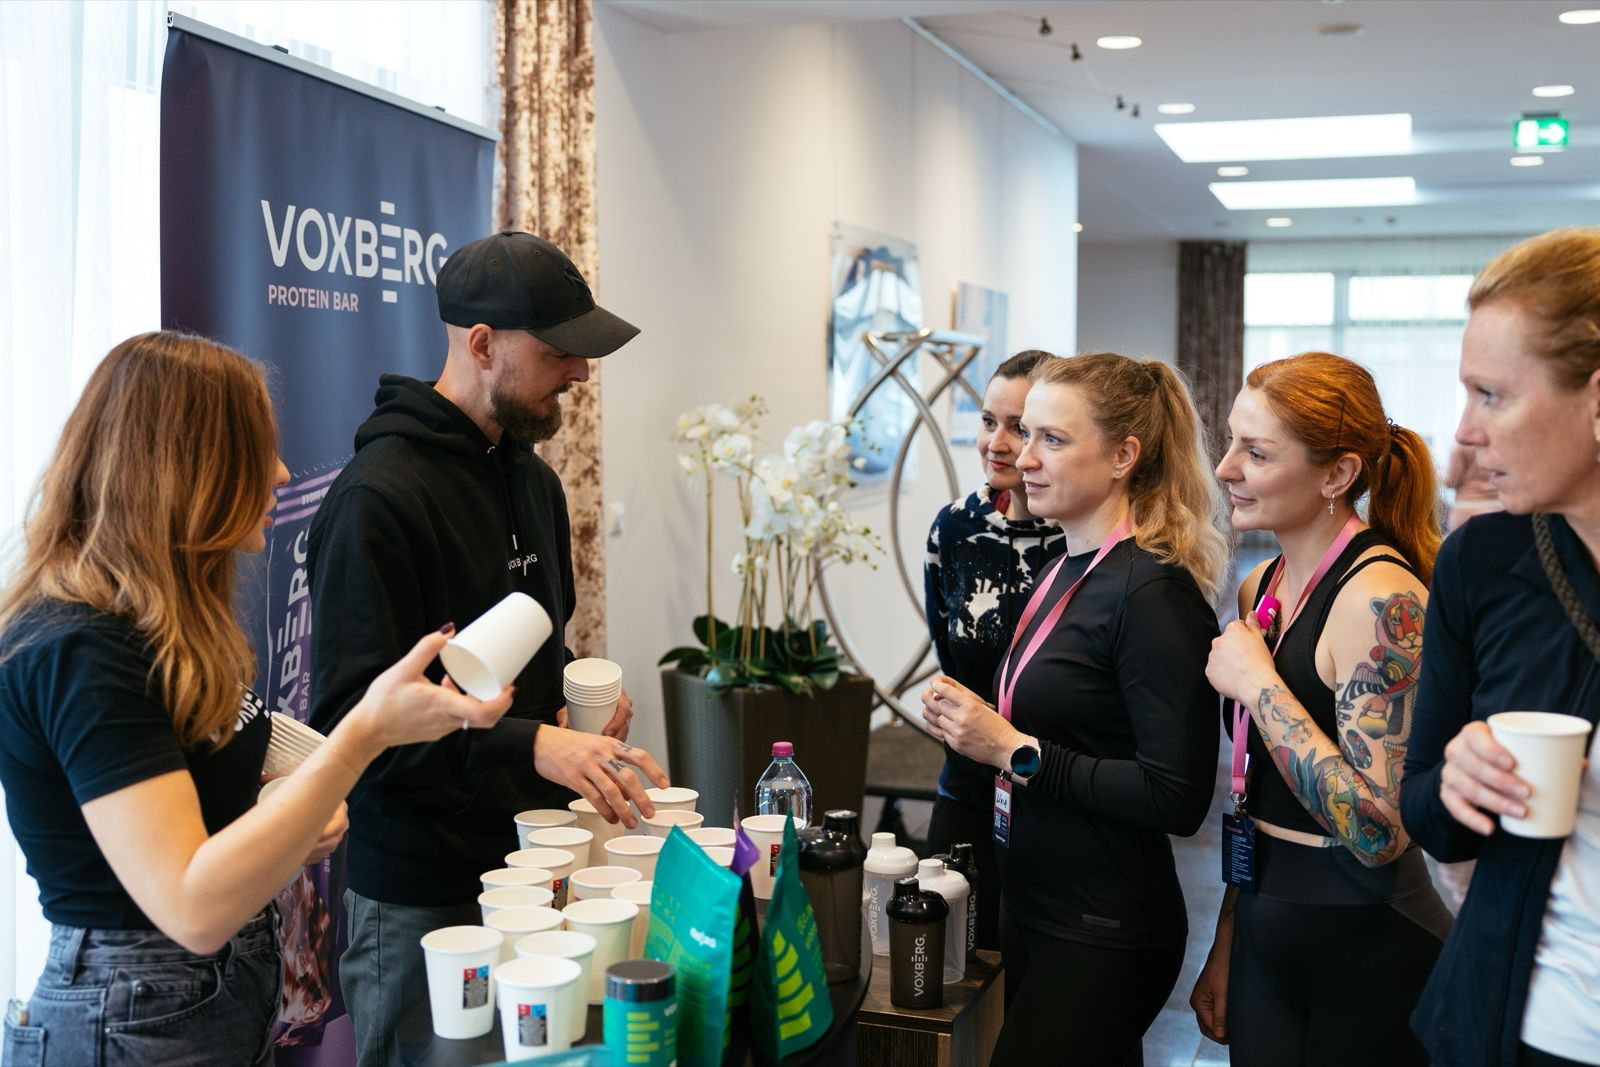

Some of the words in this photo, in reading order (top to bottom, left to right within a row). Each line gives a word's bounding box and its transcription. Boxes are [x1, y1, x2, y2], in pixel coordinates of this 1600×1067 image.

[261, 200, 448, 303] VOXBERG
[268, 284, 329, 310] PROTEIN
[333, 293, 359, 312] BAR
[300, 671, 310, 709] BAR
[967, 894, 977, 951] VOXBERG
[911, 937, 928, 997] VOXBERG
